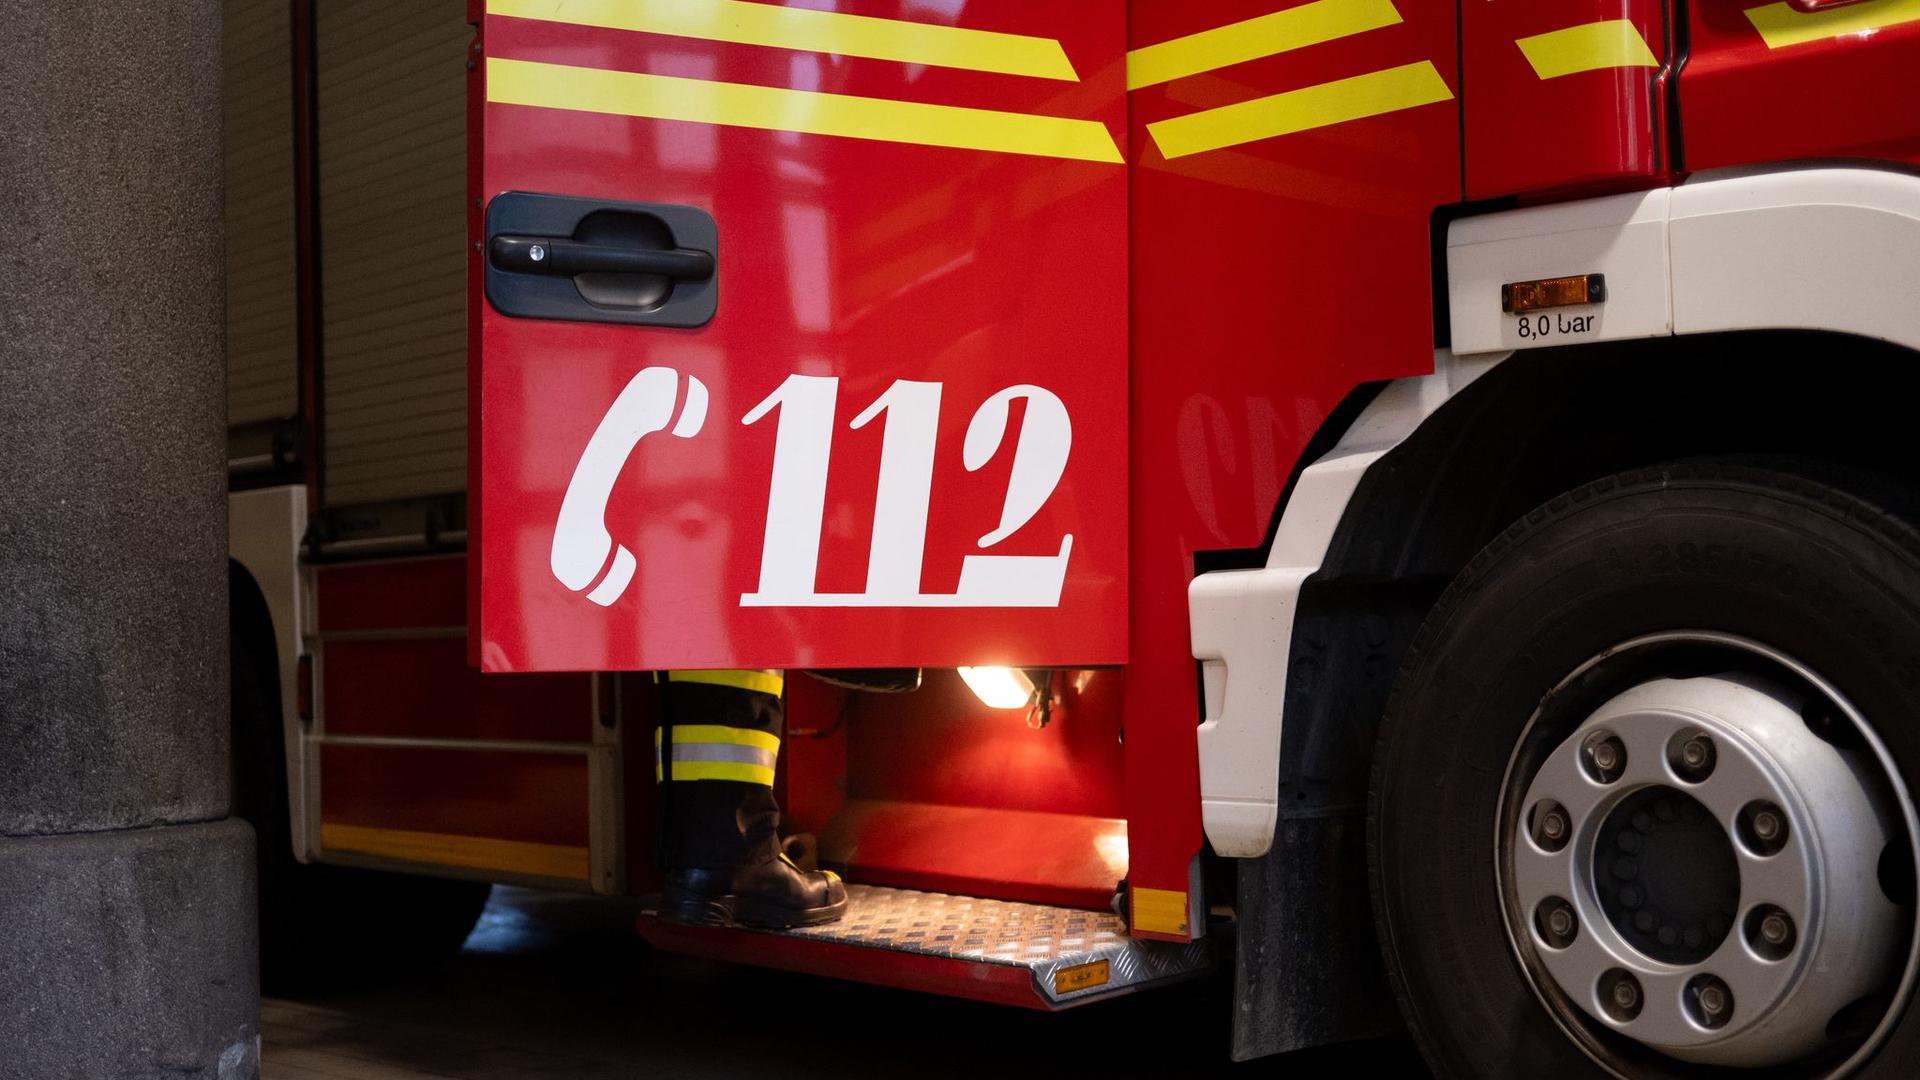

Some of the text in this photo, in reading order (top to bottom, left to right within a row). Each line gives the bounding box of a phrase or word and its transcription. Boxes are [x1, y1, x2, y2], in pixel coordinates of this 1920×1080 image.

[1518, 313, 1595, 341] 8,0 bar
[739, 373, 1073, 607] 112
